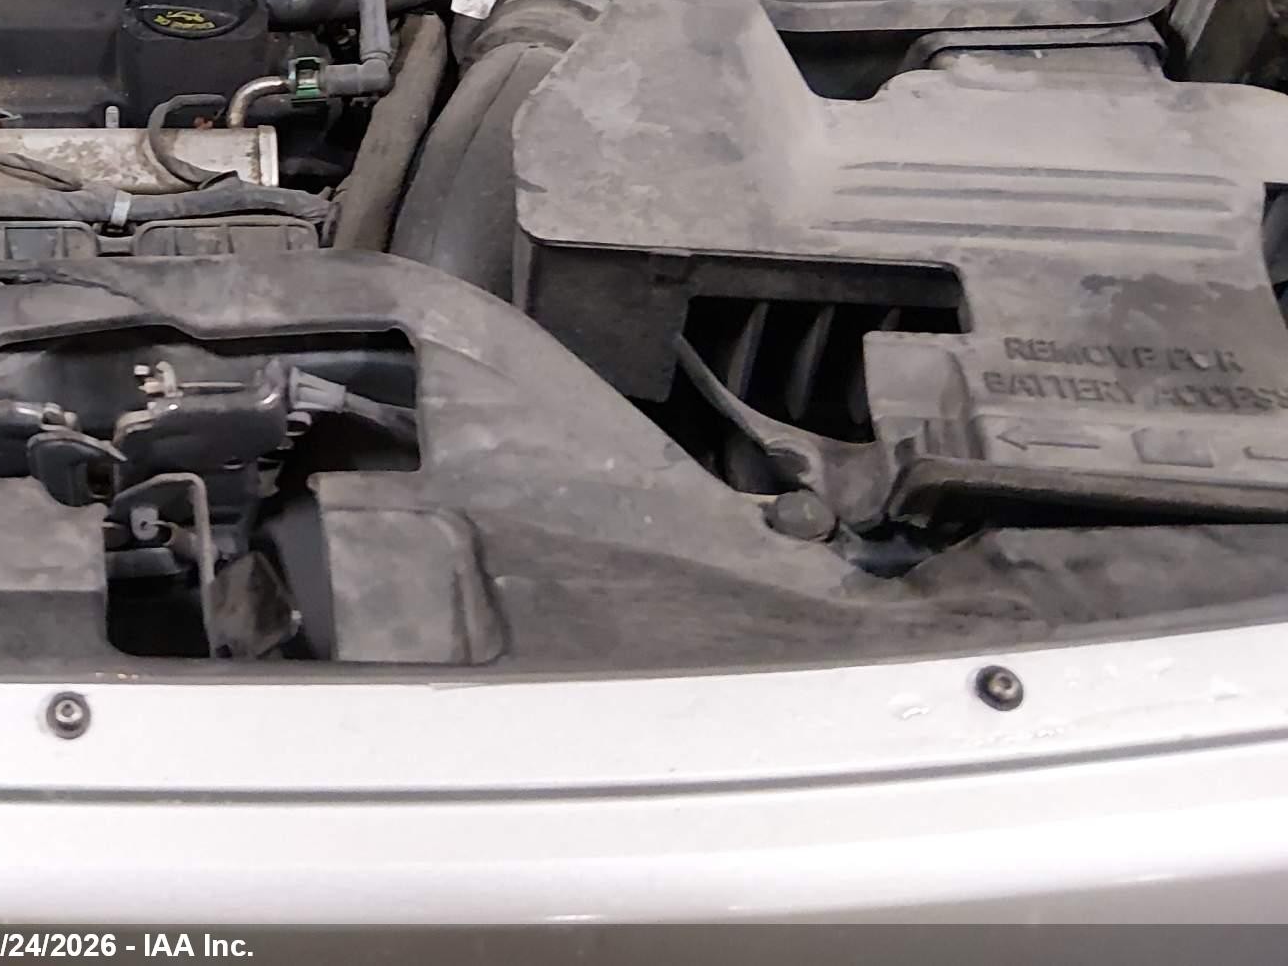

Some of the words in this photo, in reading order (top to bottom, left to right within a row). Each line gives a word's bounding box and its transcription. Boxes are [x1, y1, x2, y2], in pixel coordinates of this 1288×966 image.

[1004, 336, 1154, 369] REMOVE
[1167, 346, 1245, 373] FOR
[982, 371, 1136, 405] BATTERY
